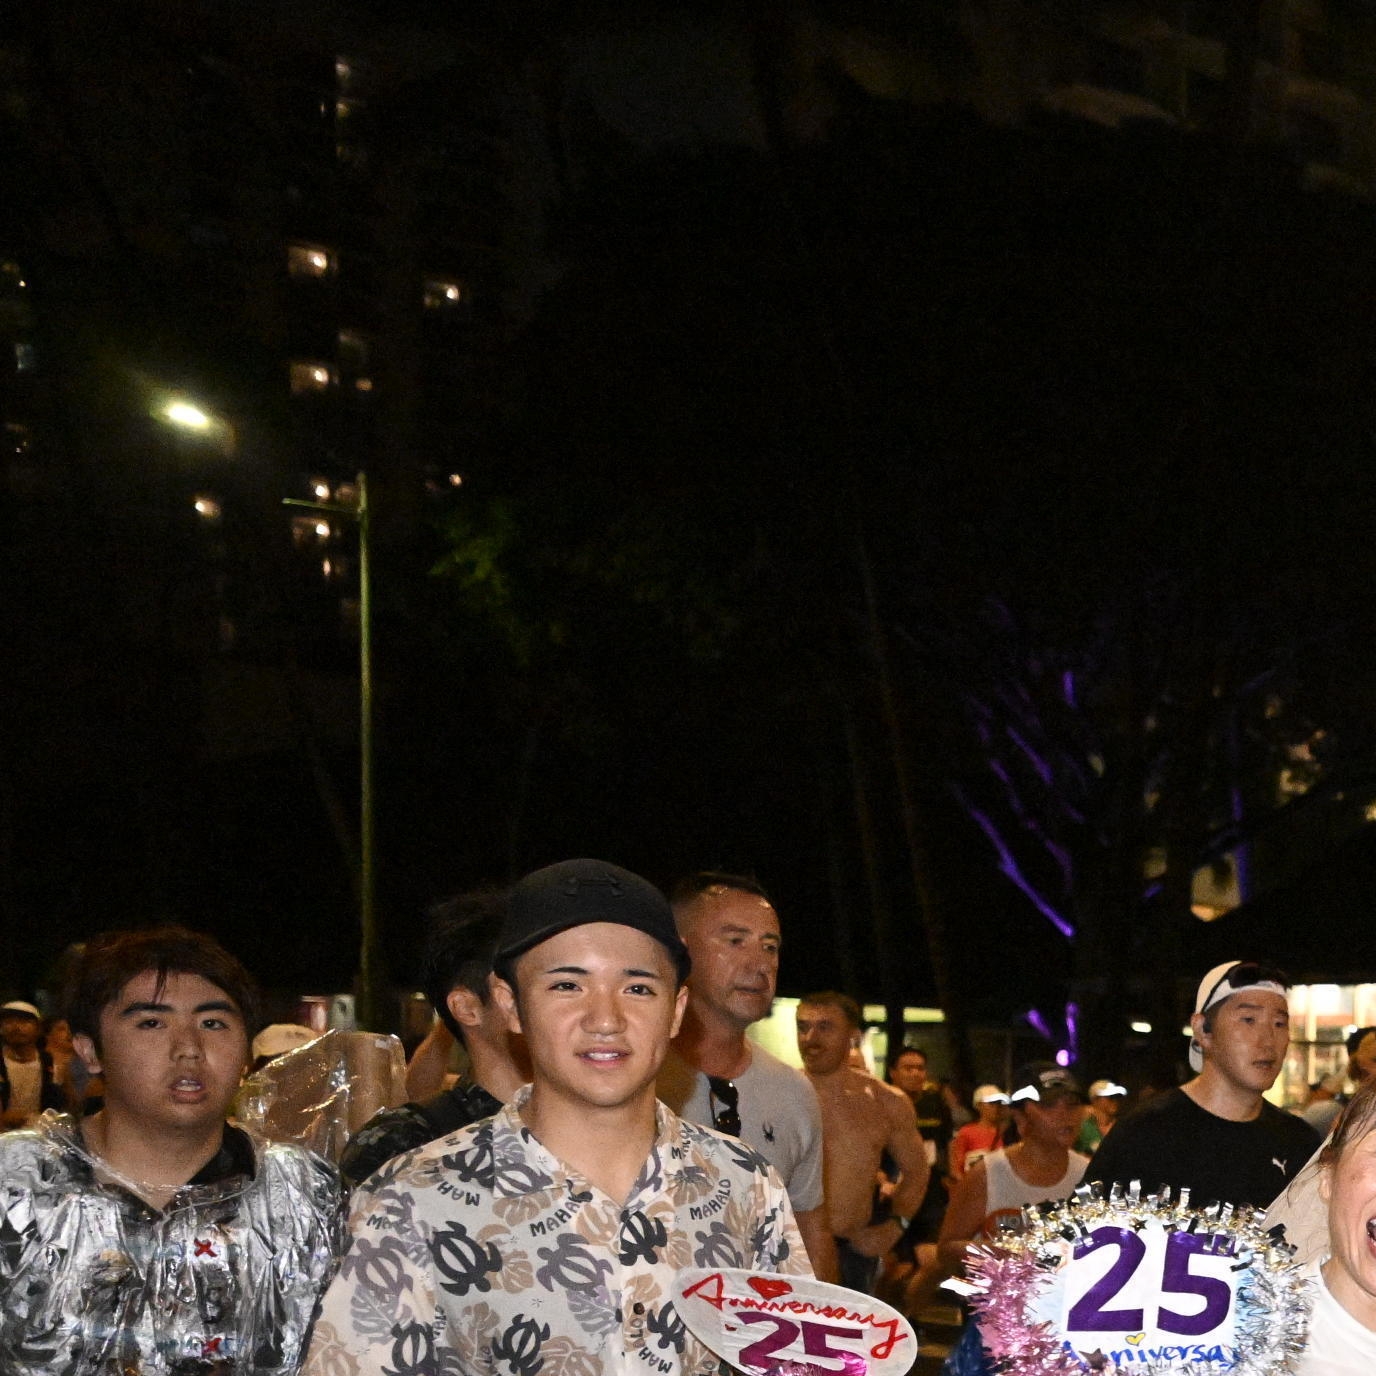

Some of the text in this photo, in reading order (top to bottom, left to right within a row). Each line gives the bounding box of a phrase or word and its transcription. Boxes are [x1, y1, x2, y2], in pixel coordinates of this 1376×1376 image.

[690, 1178, 732, 1220] MAHALO
[682, 1272, 909, 1360] Anniversary
[1066, 1225, 1237, 1336] 25
